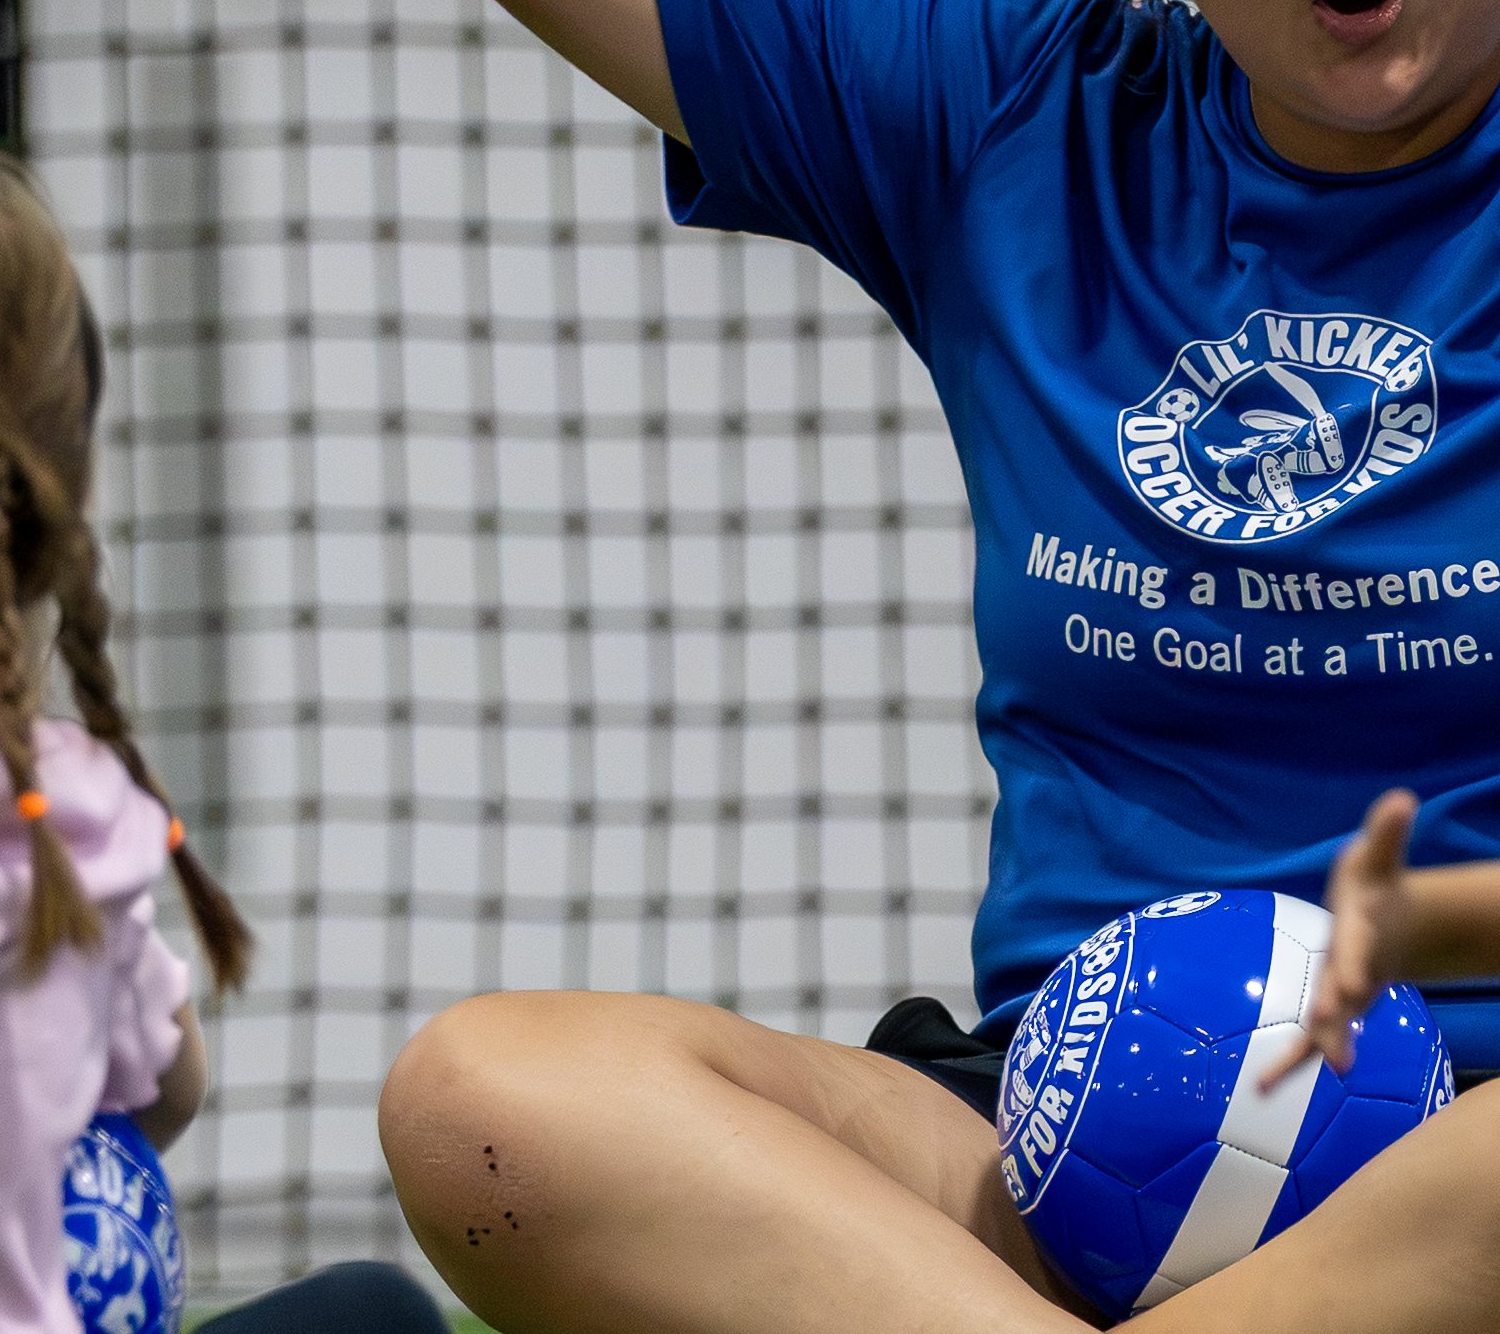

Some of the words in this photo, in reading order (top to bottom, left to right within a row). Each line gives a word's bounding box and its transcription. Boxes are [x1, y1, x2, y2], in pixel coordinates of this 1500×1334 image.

[1124, 416, 1237, 536] OCCER
[1240, 498, 1341, 538] FOR
[1342, 403, 1432, 495] KIDS
[1026, 532, 1168, 609] Making
[1190, 572, 1216, 606] a
[1065, 613, 1136, 662] One
[1153, 627, 1242, 673] Goal
[1264, 637, 1305, 676] at
[1324, 645, 1348, 676] a
[1366, 631, 1493, 673] Time.
[1019, 1084, 1075, 1178] FOR
[1053, 972, 1117, 1079] KIDS
